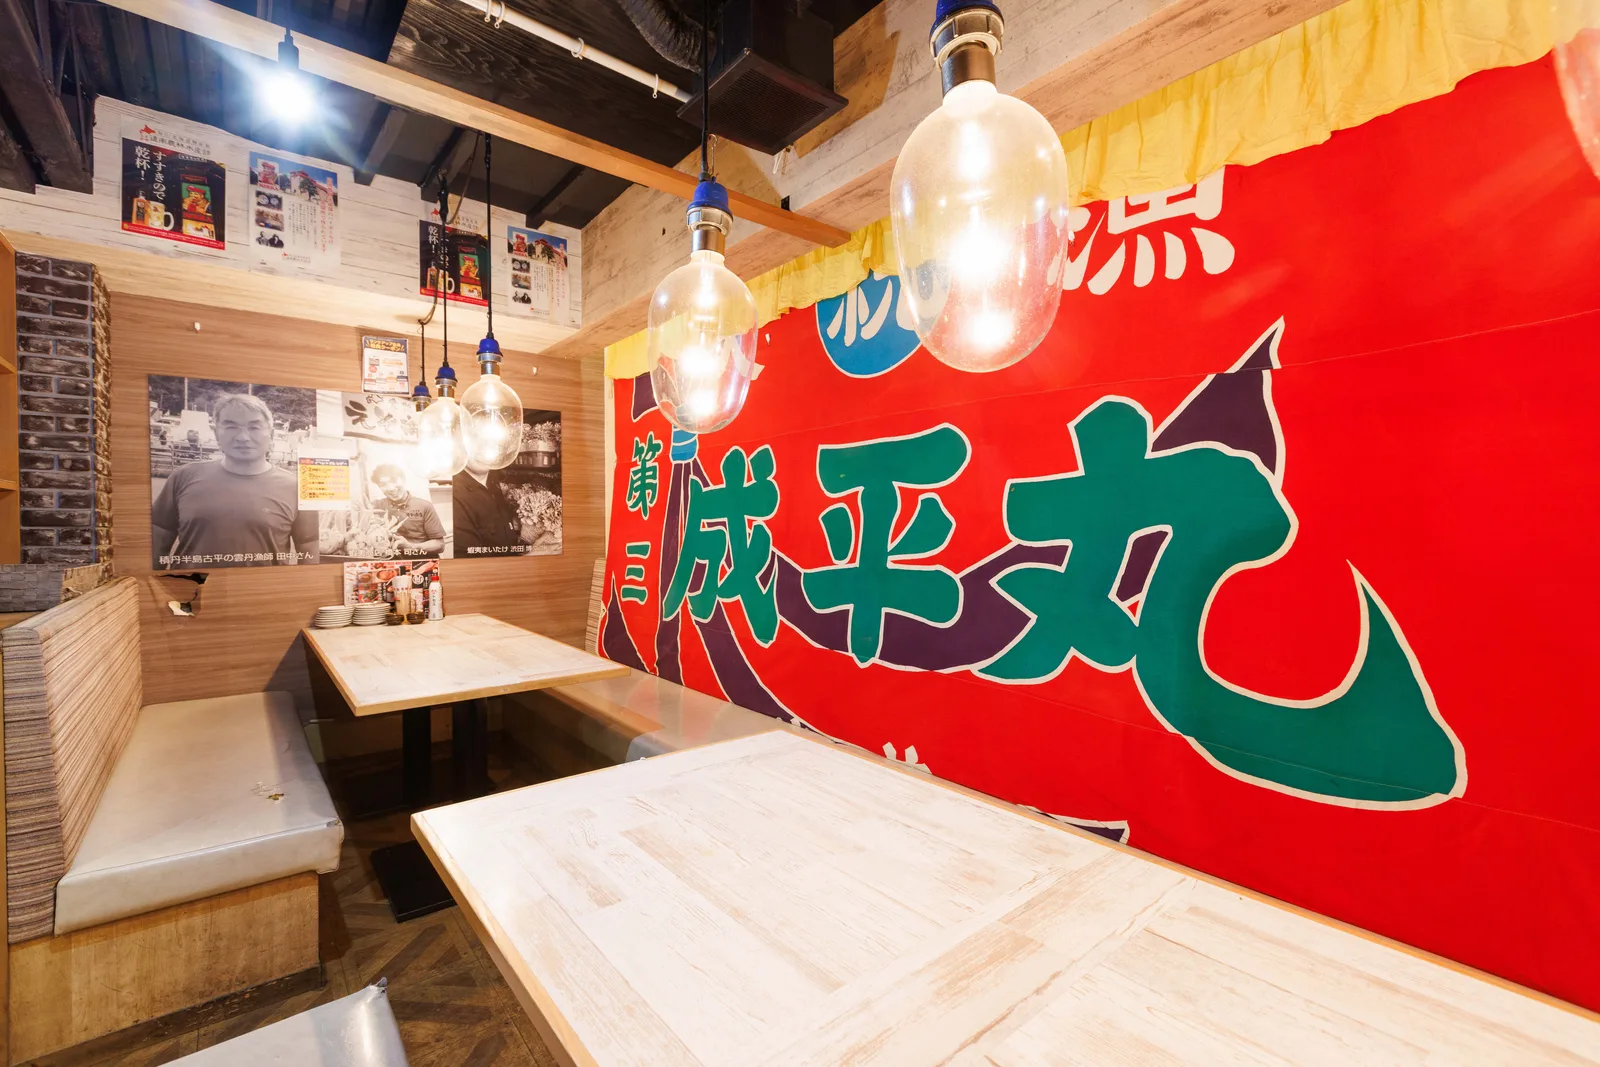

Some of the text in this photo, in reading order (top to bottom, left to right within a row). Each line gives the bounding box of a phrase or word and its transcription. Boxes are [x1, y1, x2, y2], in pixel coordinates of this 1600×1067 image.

[152, 151, 167, 201] すすきので
[619, 430, 663, 606] 第三
[158, 551, 314, 565] 積丹半島古平の雲丹漁師 田中さん
[466, 545, 508, 555] 蝦夷まいたけ
[662, 394, 1468, 814] 成平丸
